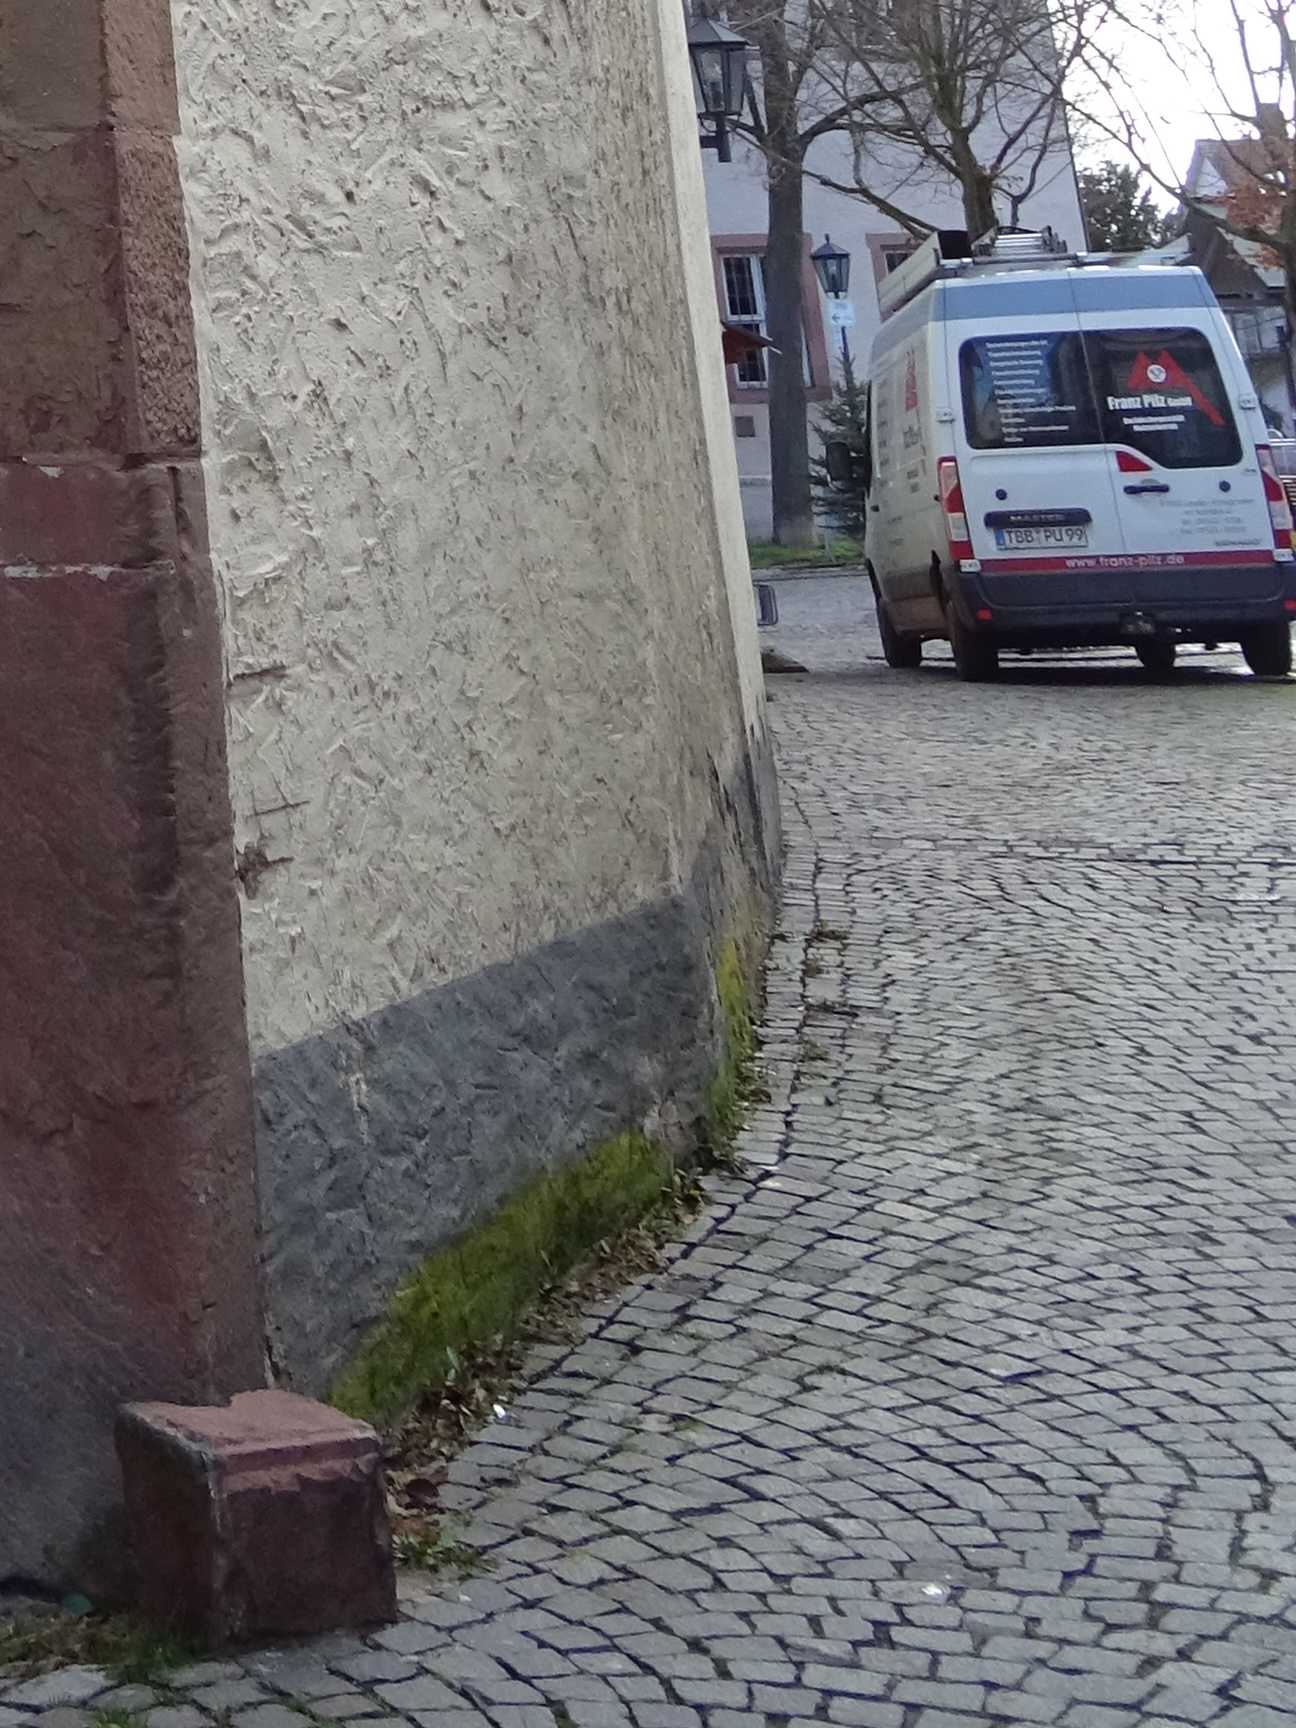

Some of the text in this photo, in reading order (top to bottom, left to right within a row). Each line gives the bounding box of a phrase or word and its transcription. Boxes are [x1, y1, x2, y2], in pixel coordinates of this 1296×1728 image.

[1106, 396, 1143, 411] Franz
[1143, 393, 1167, 408] Pilz
[1006, 529, 1034, 544] TBB
[1065, 554, 1185, 569] www.franz-pilz.de
